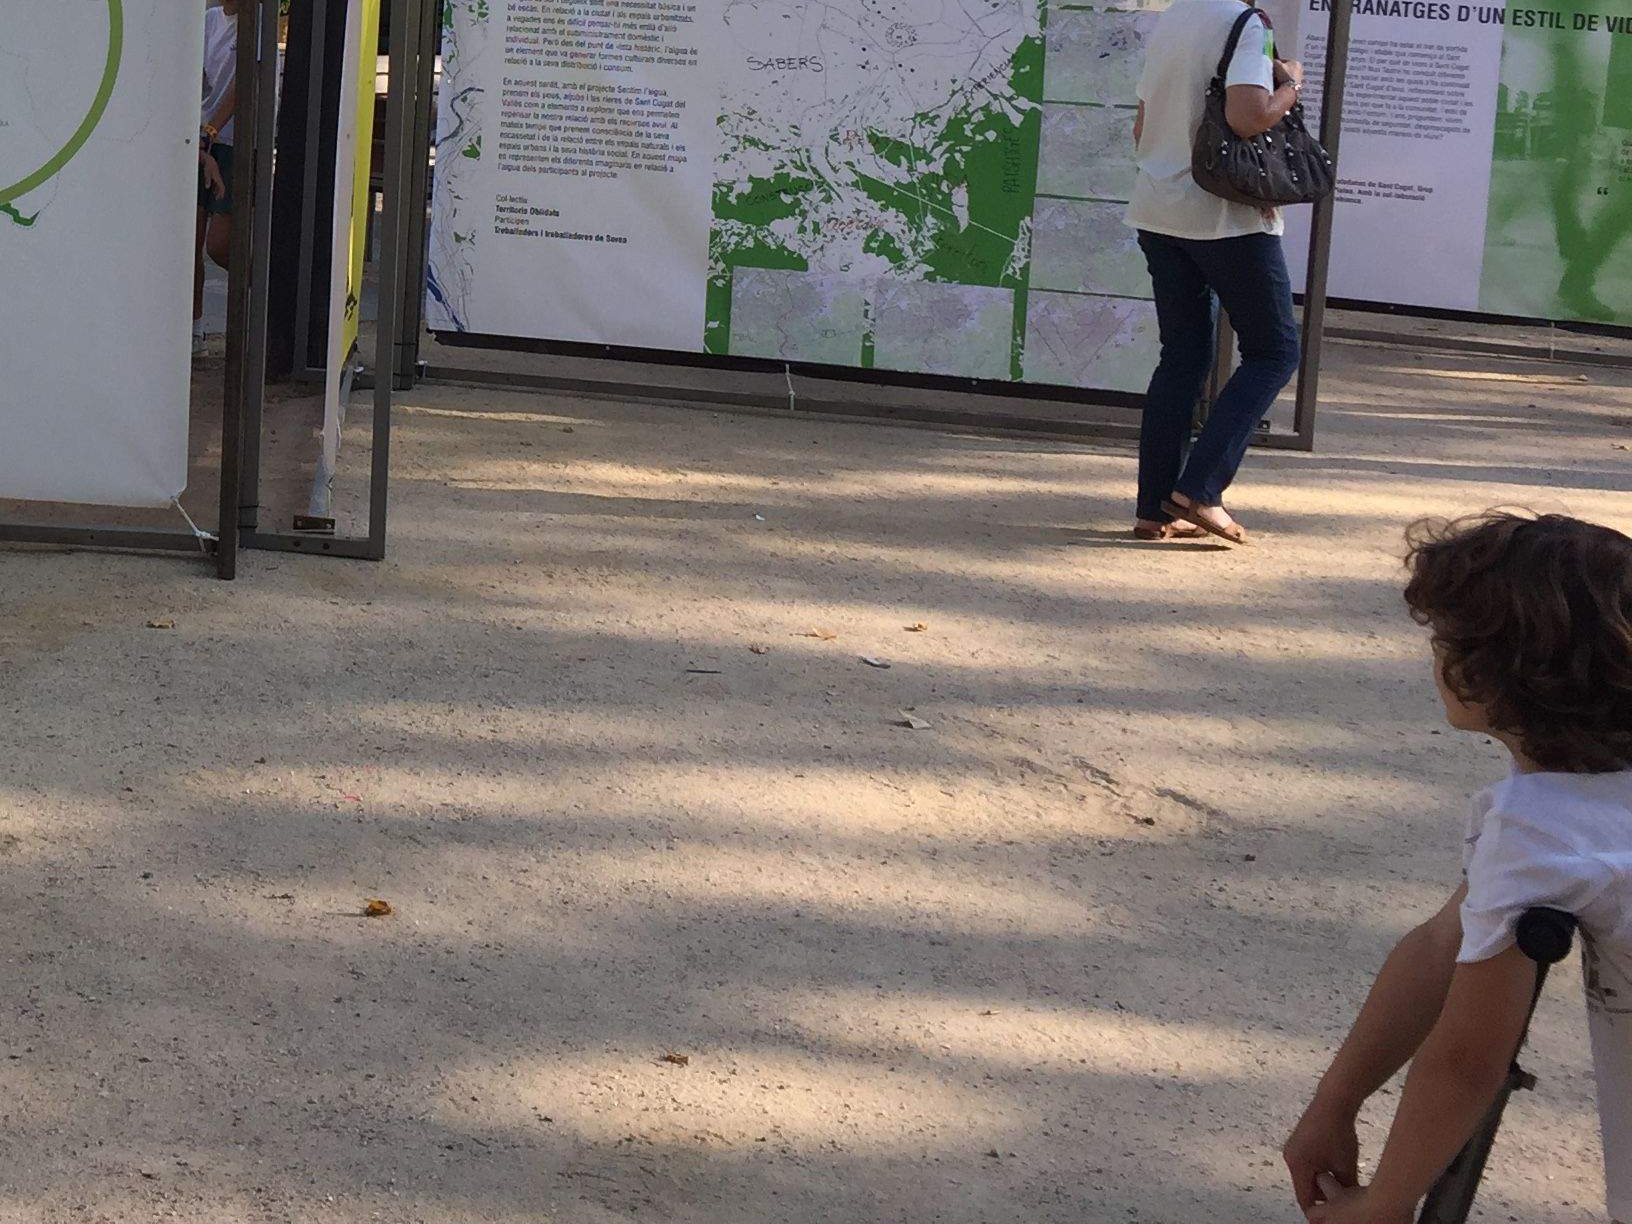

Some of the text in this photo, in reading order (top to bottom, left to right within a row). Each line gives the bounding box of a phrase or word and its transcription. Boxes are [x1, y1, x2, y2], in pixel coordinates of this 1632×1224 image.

[1457, 5, 1506, 25] D'UN
[1512, 9, 1566, 30] ESTIL
[1573, 13, 1598, 32] DE
[746, 56, 824, 73] SABERS
